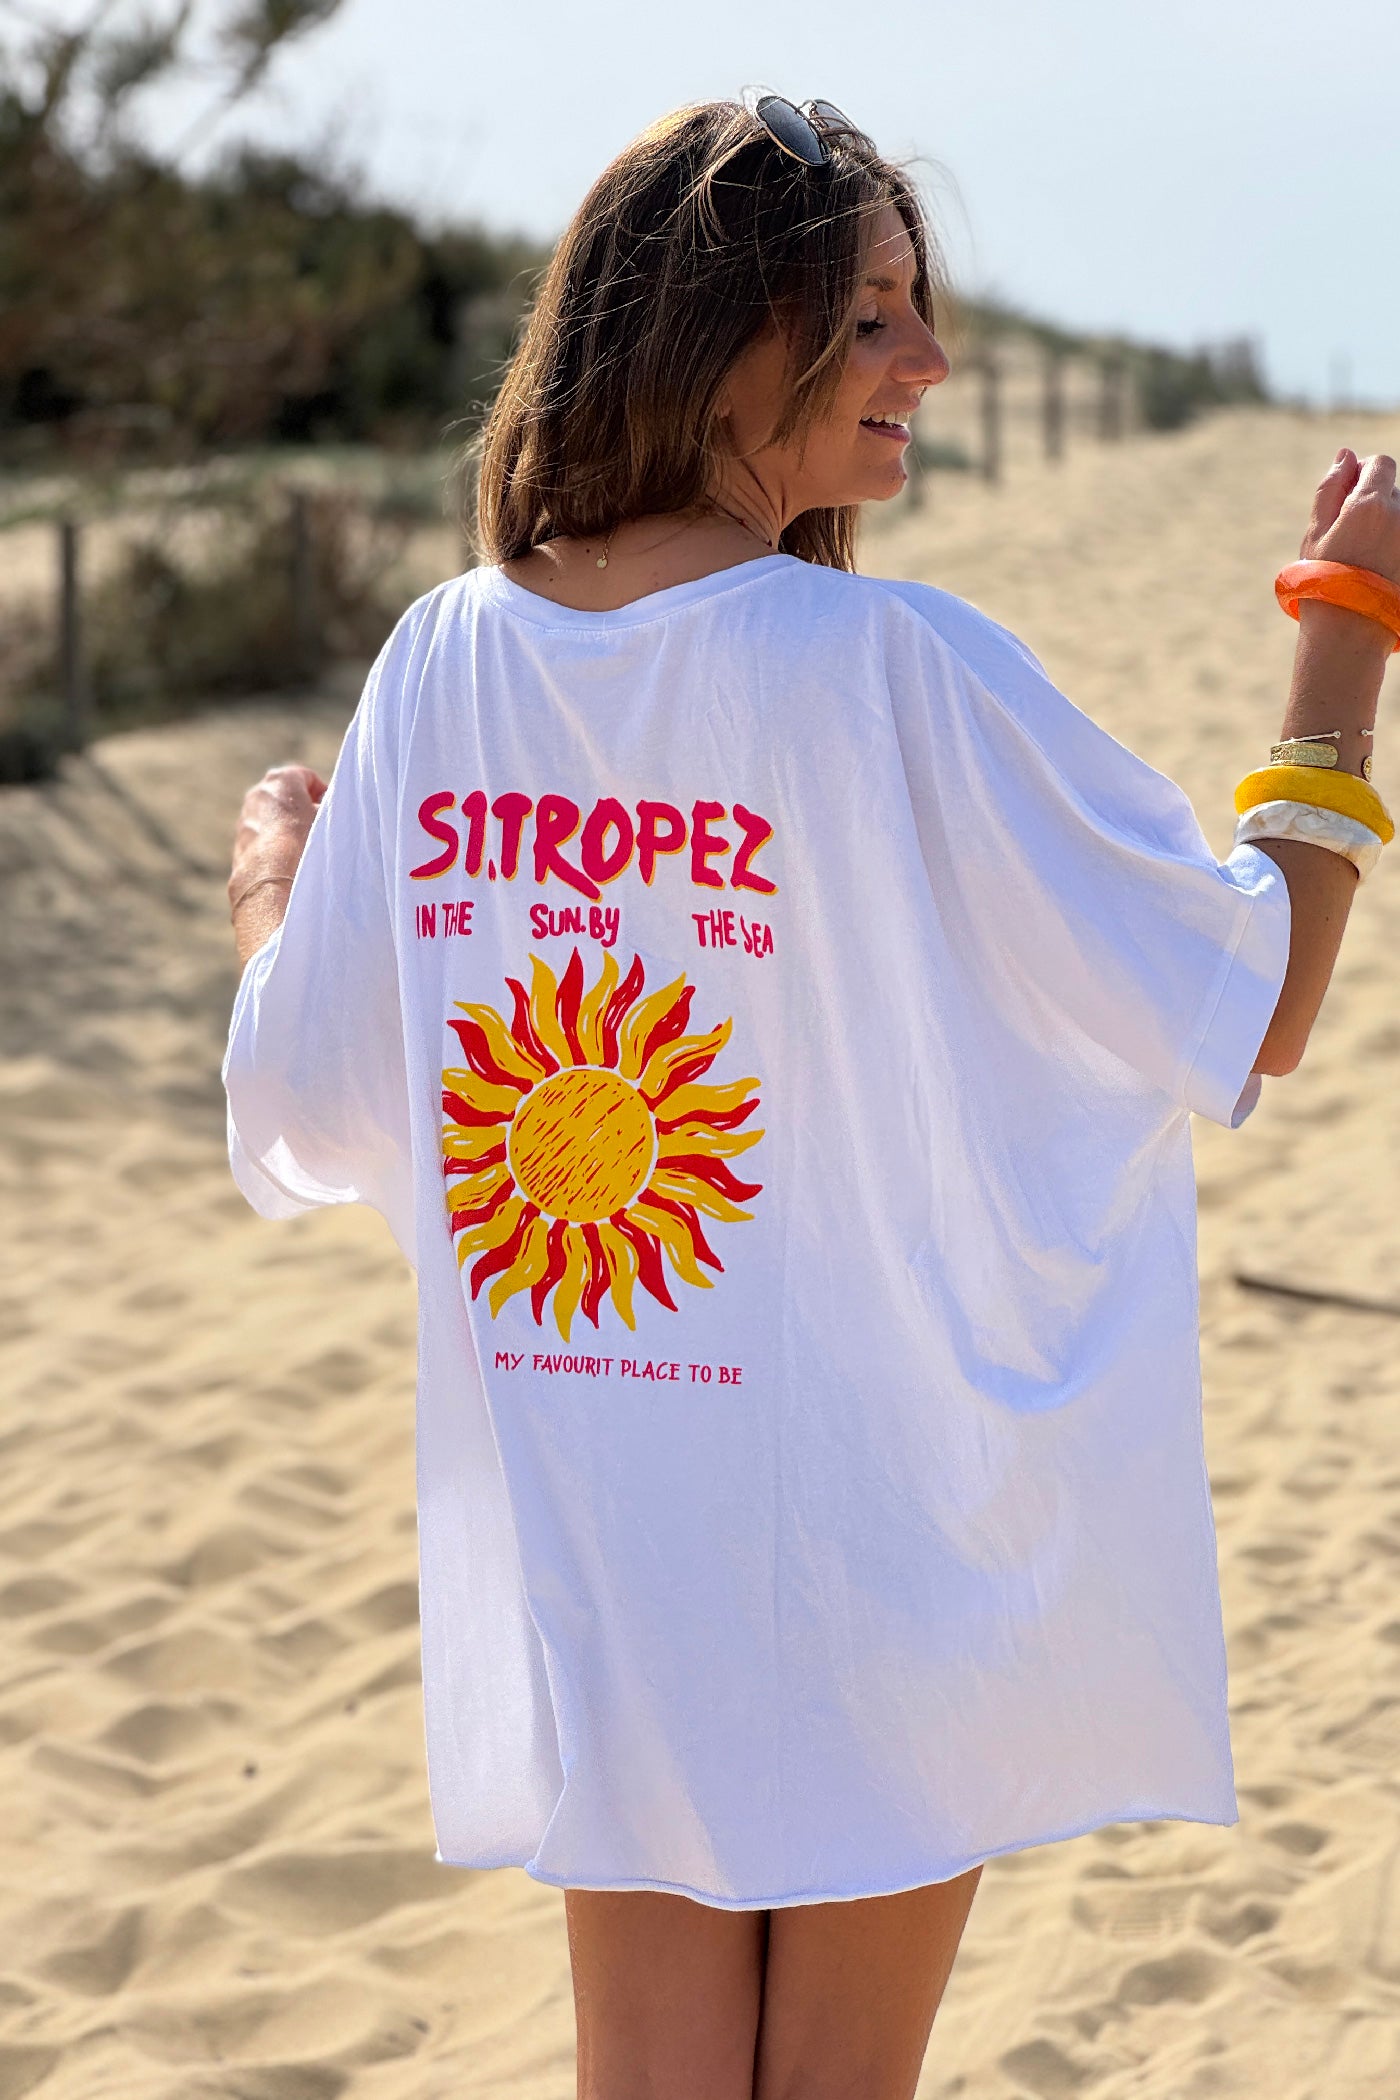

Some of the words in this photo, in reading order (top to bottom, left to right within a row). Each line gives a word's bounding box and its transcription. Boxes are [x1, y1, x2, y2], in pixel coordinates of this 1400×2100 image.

[416, 902, 437, 939] IN
[442, 901, 475, 938] THE
[691, 908, 738, 949] THE
[739, 914, 774, 959] SEA
[495, 1351, 525, 1371] MY
[533, 1353, 614, 1378] FAVOURIT
[621, 1359, 681, 1382] PLACE
[689, 1363, 712, 1384] TO
[719, 1365, 743, 1386] BE
